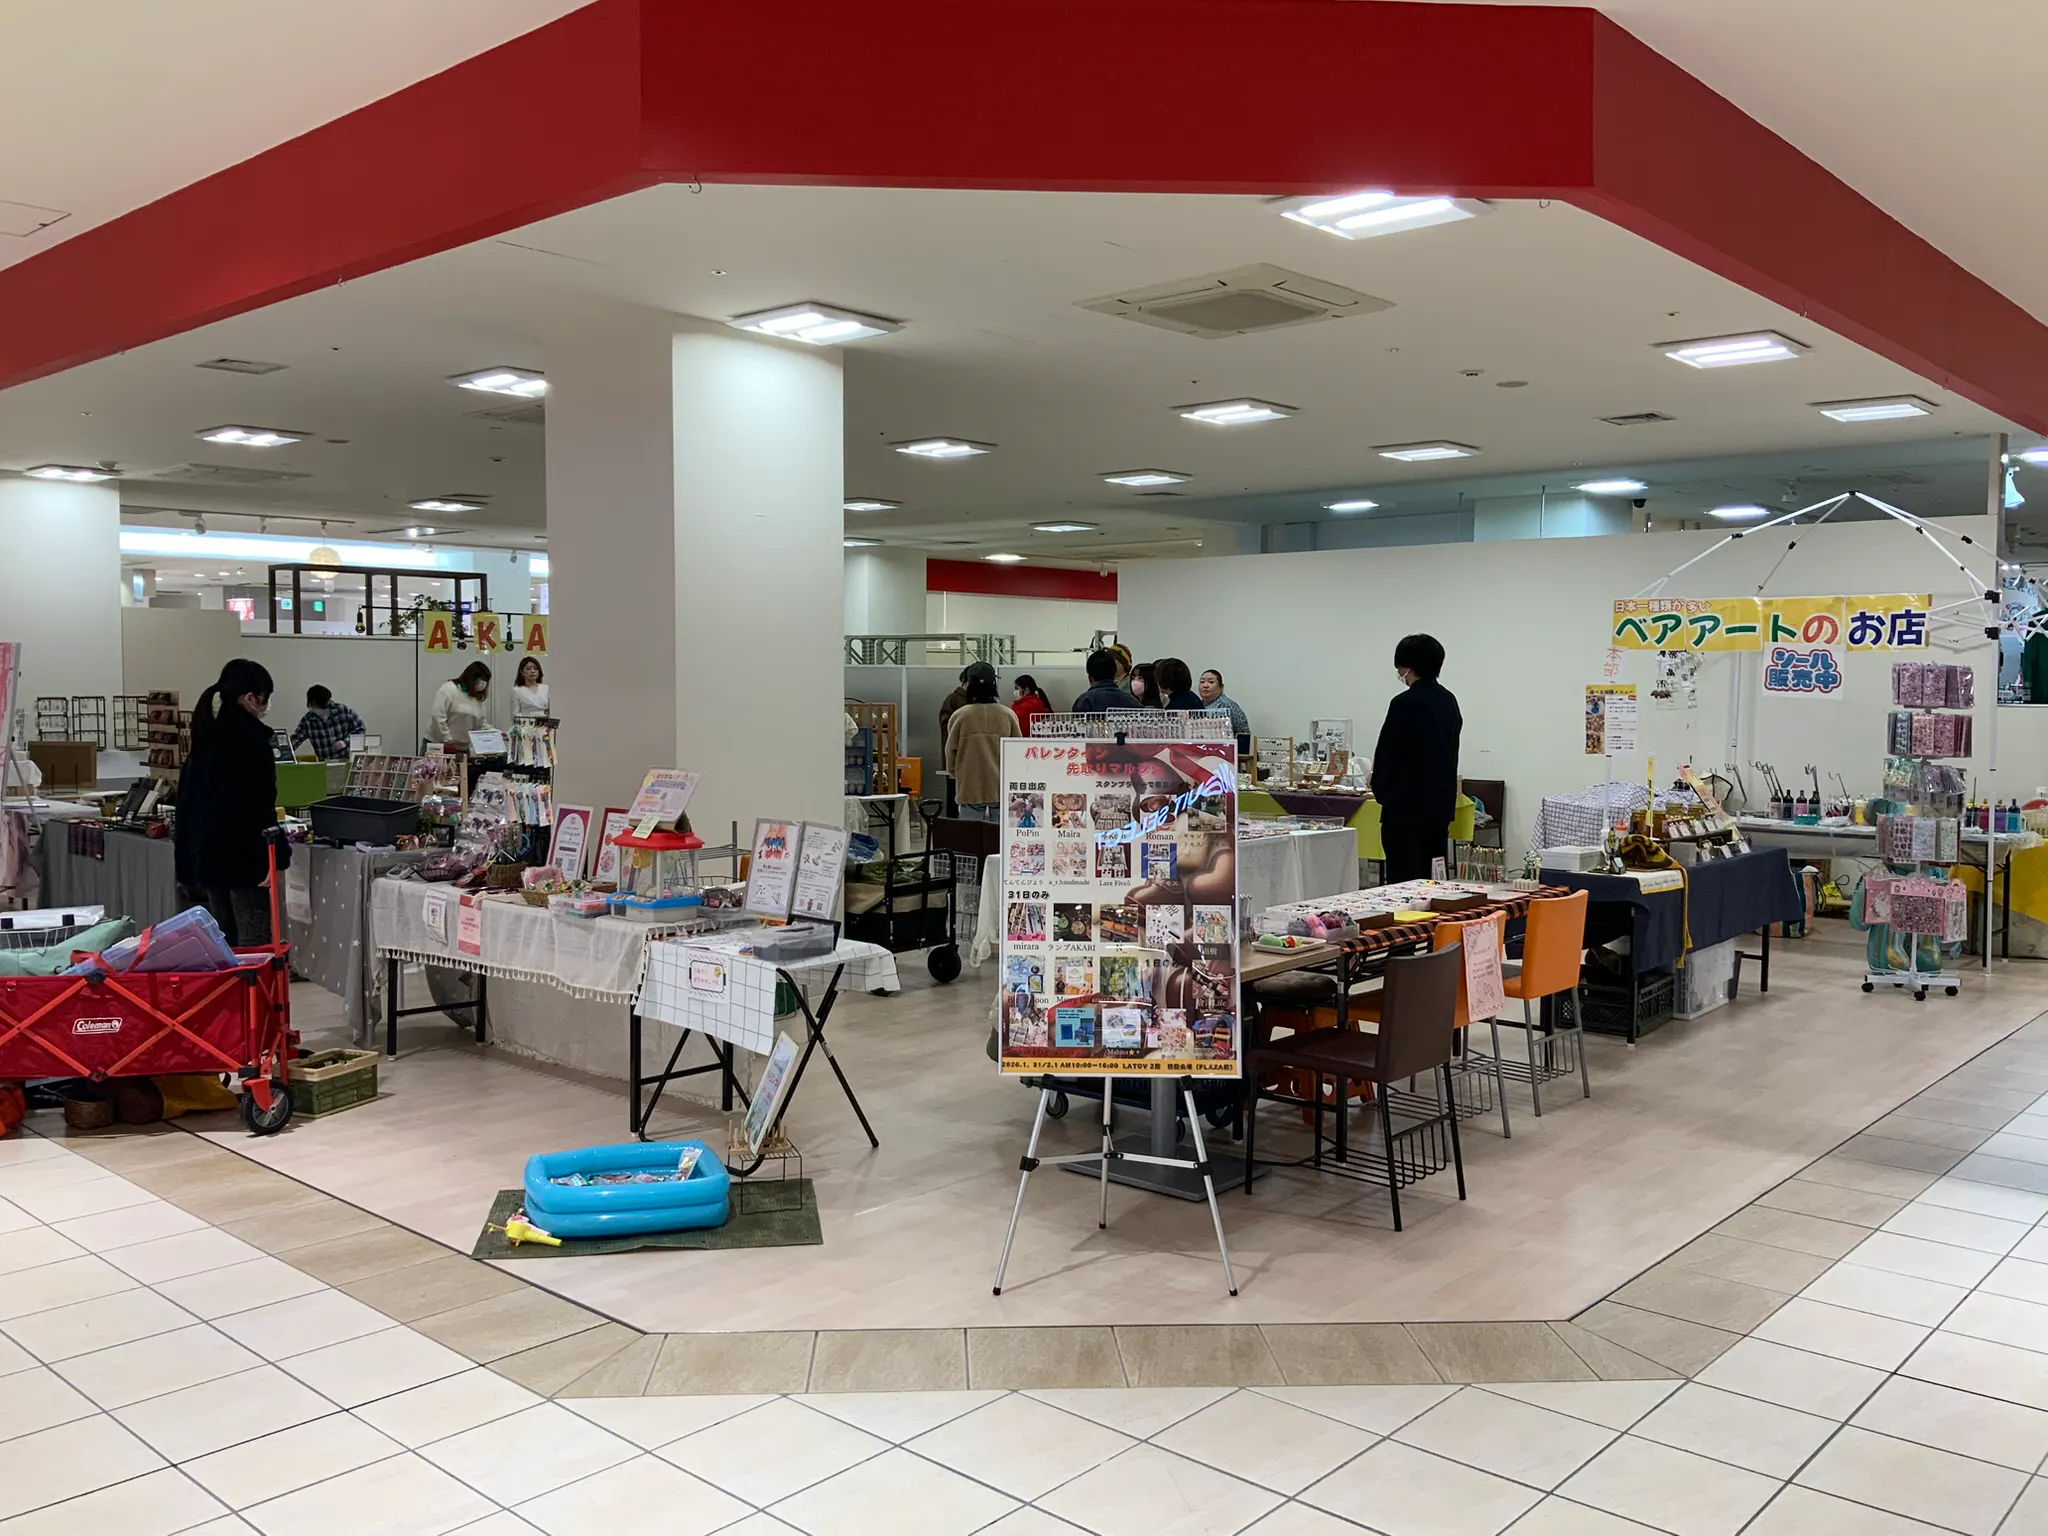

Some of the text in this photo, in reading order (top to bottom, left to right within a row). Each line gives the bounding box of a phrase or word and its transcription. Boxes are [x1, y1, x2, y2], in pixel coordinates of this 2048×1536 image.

[1614, 600, 1711, 613] 日本一種類が多い
[1614, 608, 1927, 648] ベアアートのお店
[1602, 647, 1624, 677] 本部
[1774, 650, 1834, 669] シール
[1768, 668, 1838, 690] 販売中
[1024, 746, 1109, 760] バレンタイン
[1009, 782, 1047, 791] 両日出店
[1016, 829, 1040, 838] PoPin
[1057, 830, 1081, 838] Maira
[1007, 890, 1051, 901] 31日のみ
[76, 1020, 111, 1031] Coleman
